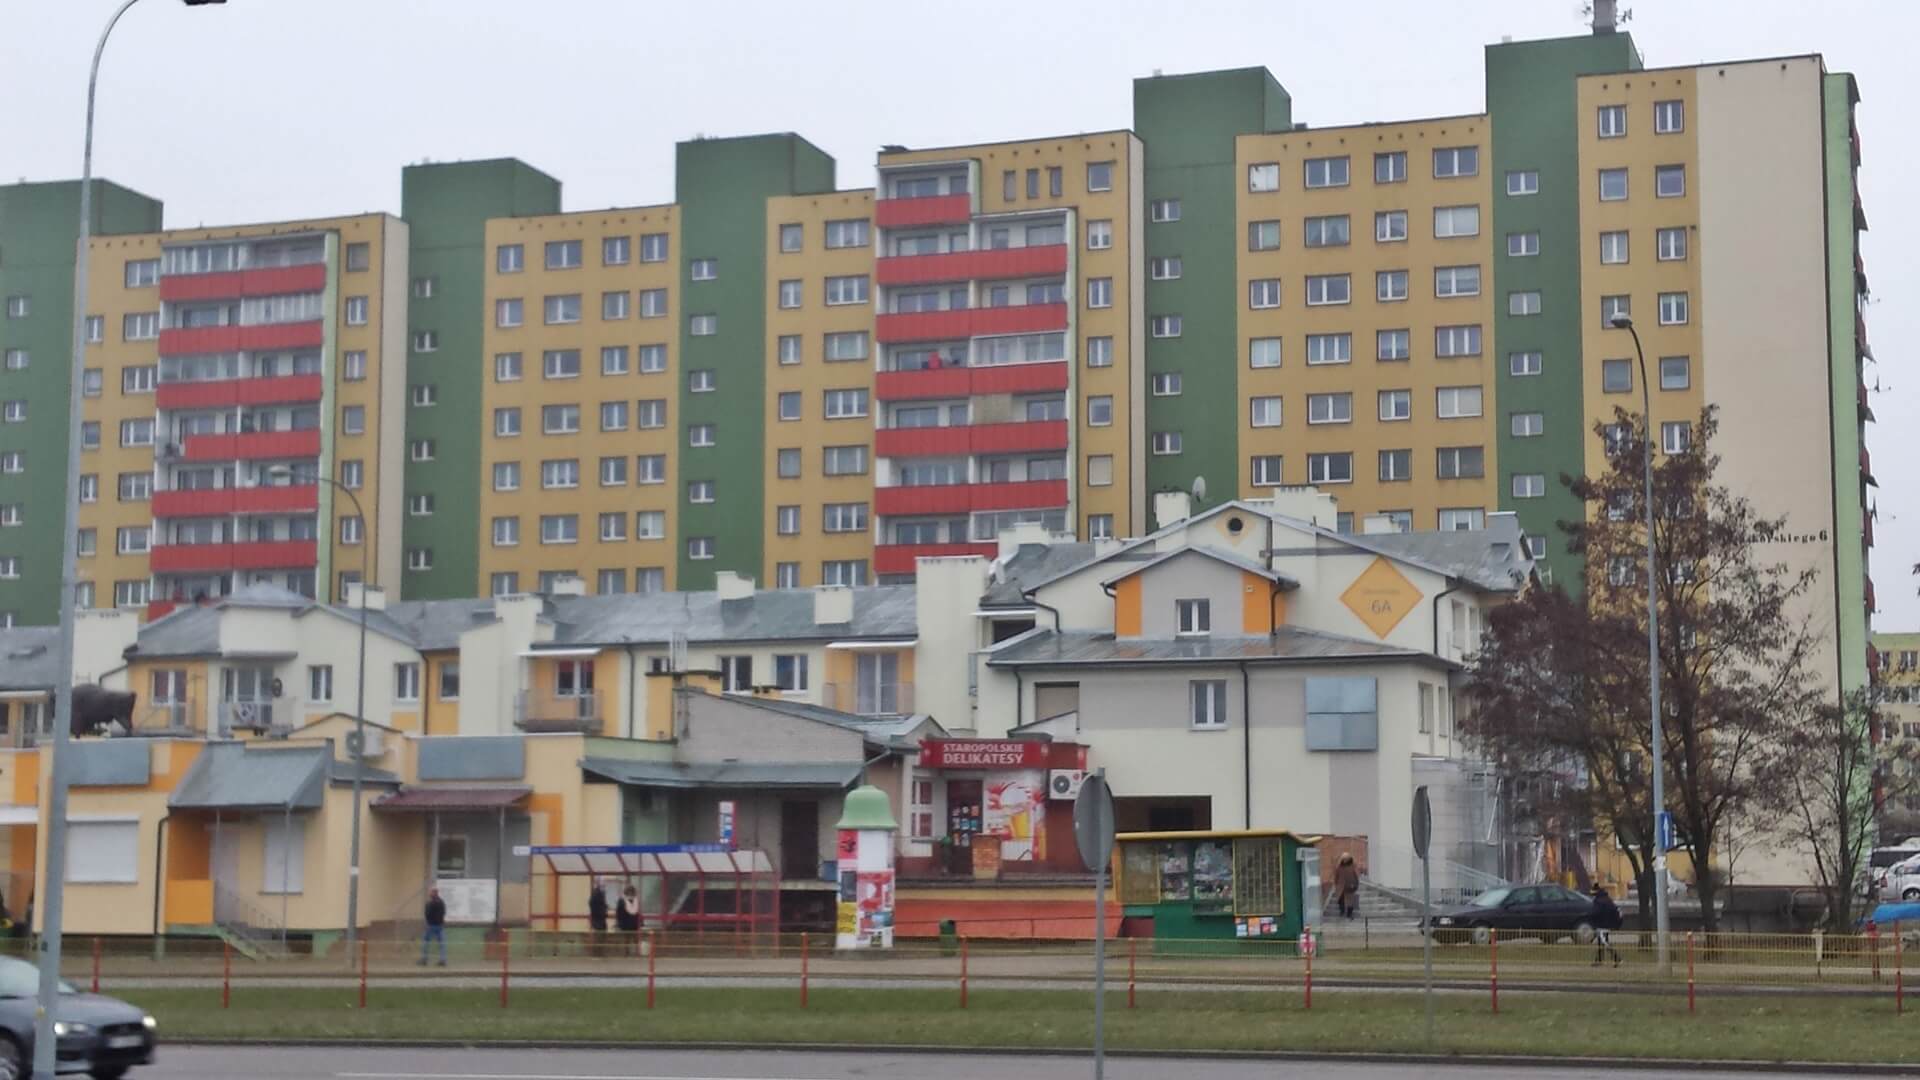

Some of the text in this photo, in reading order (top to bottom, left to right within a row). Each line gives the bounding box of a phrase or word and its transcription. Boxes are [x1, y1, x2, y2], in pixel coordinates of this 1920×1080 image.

[1819, 529, 1828, 542] 6
[1371, 599, 1392, 615] 6A
[943, 743, 1024, 753] STAROPOLSKIE
[943, 753, 1024, 764] DELIKATESY
